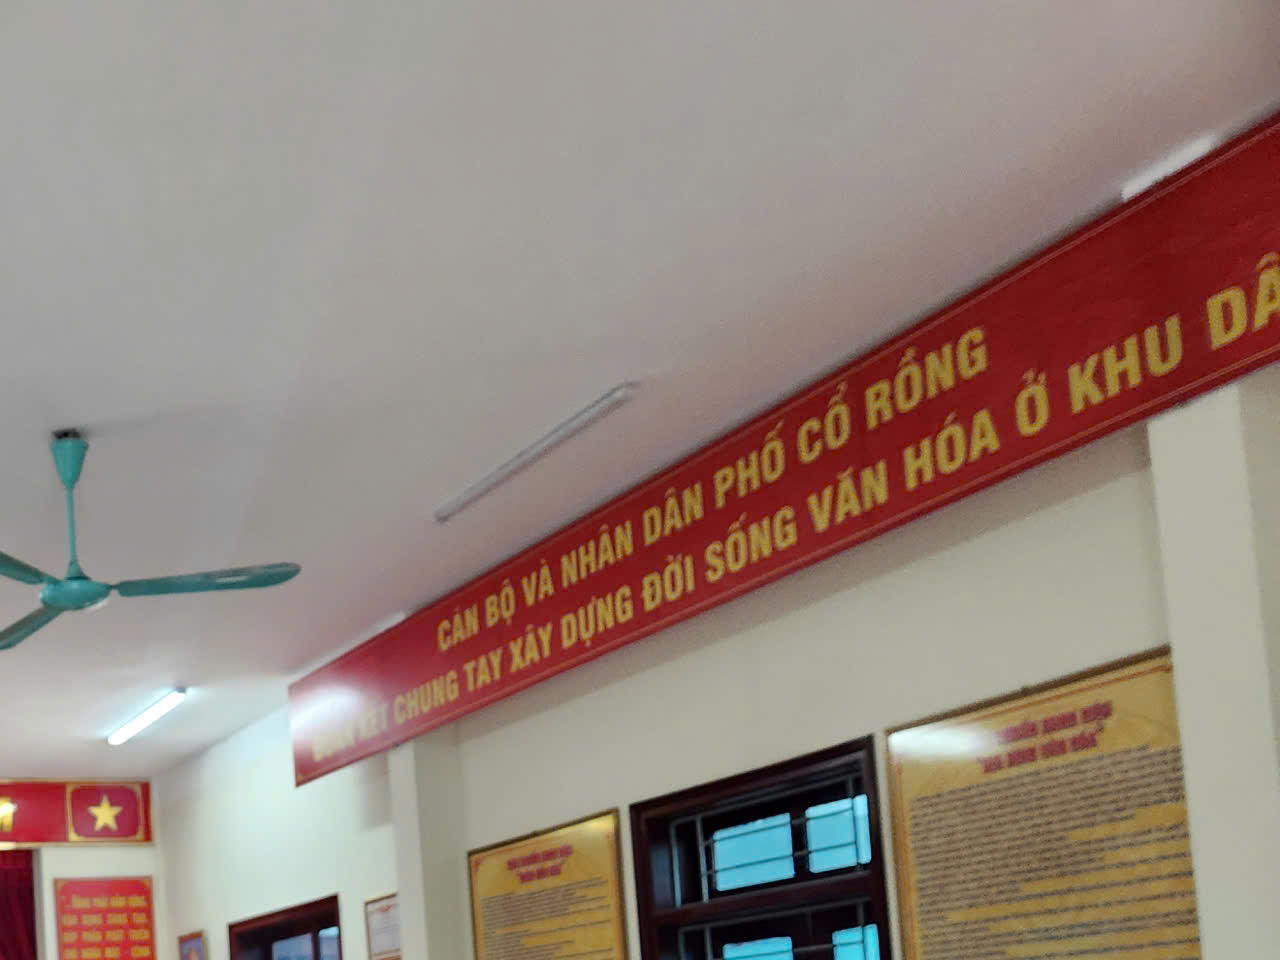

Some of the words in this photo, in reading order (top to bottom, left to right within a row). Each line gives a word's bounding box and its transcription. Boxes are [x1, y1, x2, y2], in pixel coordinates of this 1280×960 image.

[394, 675, 459, 724] CHUNG
[463, 649, 503, 694] TAY
[510, 624, 552, 673] XÂY
[561, 586, 634, 649] DỰNG
[641, 554, 695, 614] ĐỜI
[705, 507, 798, 584] SỐNG
[807, 460, 889, 535] VĂN
[903, 409, 1001, 492] HÓA
[1015, 369, 1050, 438] Ở
[1068, 314, 1184, 414] KHU
[485, 580, 516, 627] BỘ
[521, 560, 554, 606] VÀ
[561, 520, 633, 588] NHÂN
[643, 483, 704, 546] DÂN
[714, 421, 785, 508] PHỐ
